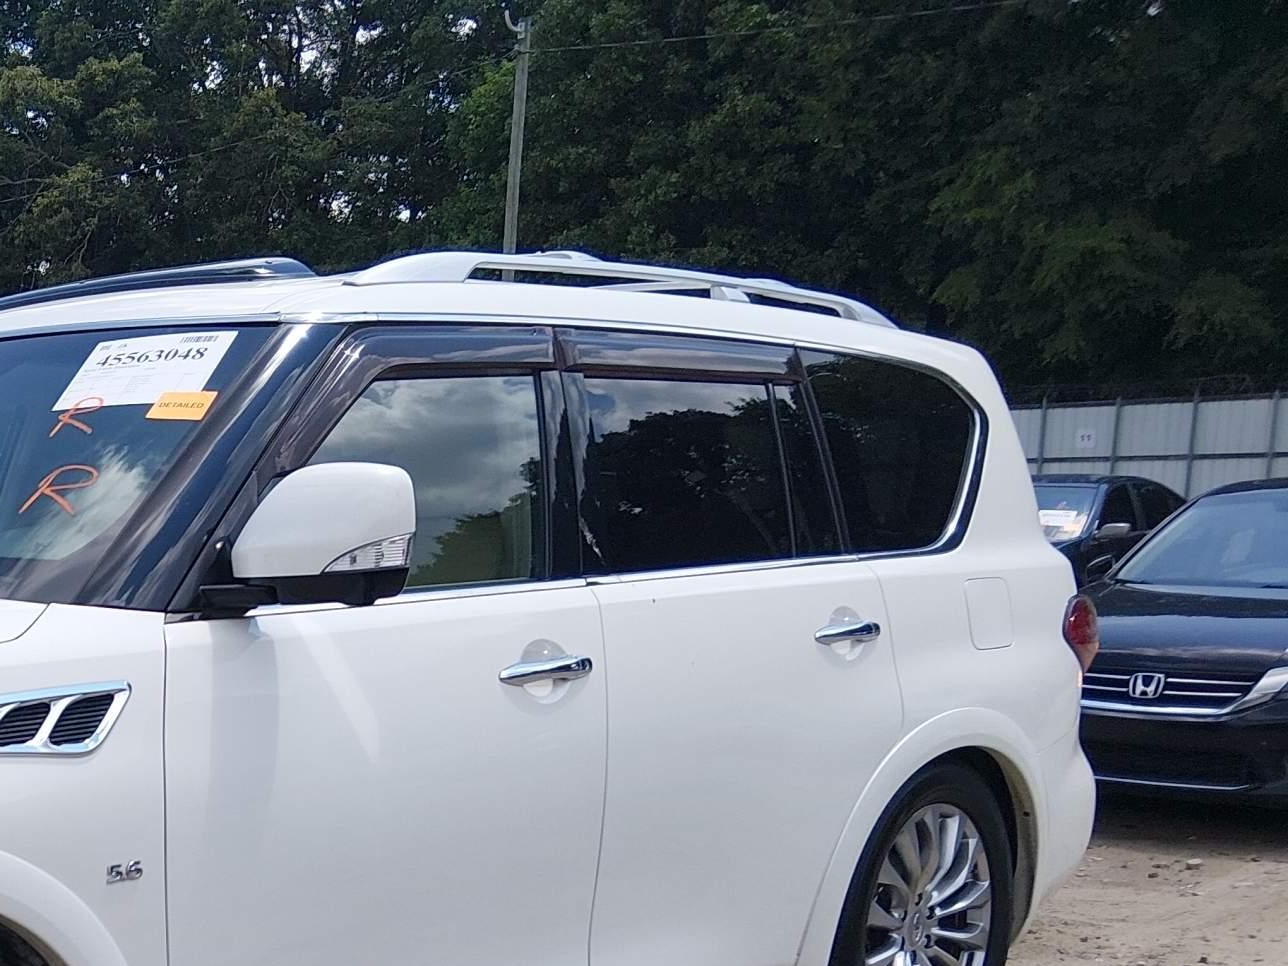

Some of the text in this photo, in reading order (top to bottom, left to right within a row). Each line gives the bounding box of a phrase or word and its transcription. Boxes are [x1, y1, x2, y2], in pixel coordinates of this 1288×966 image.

[96, 346, 208, 368] 45563048
[49, 397, 104, 438] R
[158, 401, 205, 409] DETAILED
[18, 464, 99, 515] R
